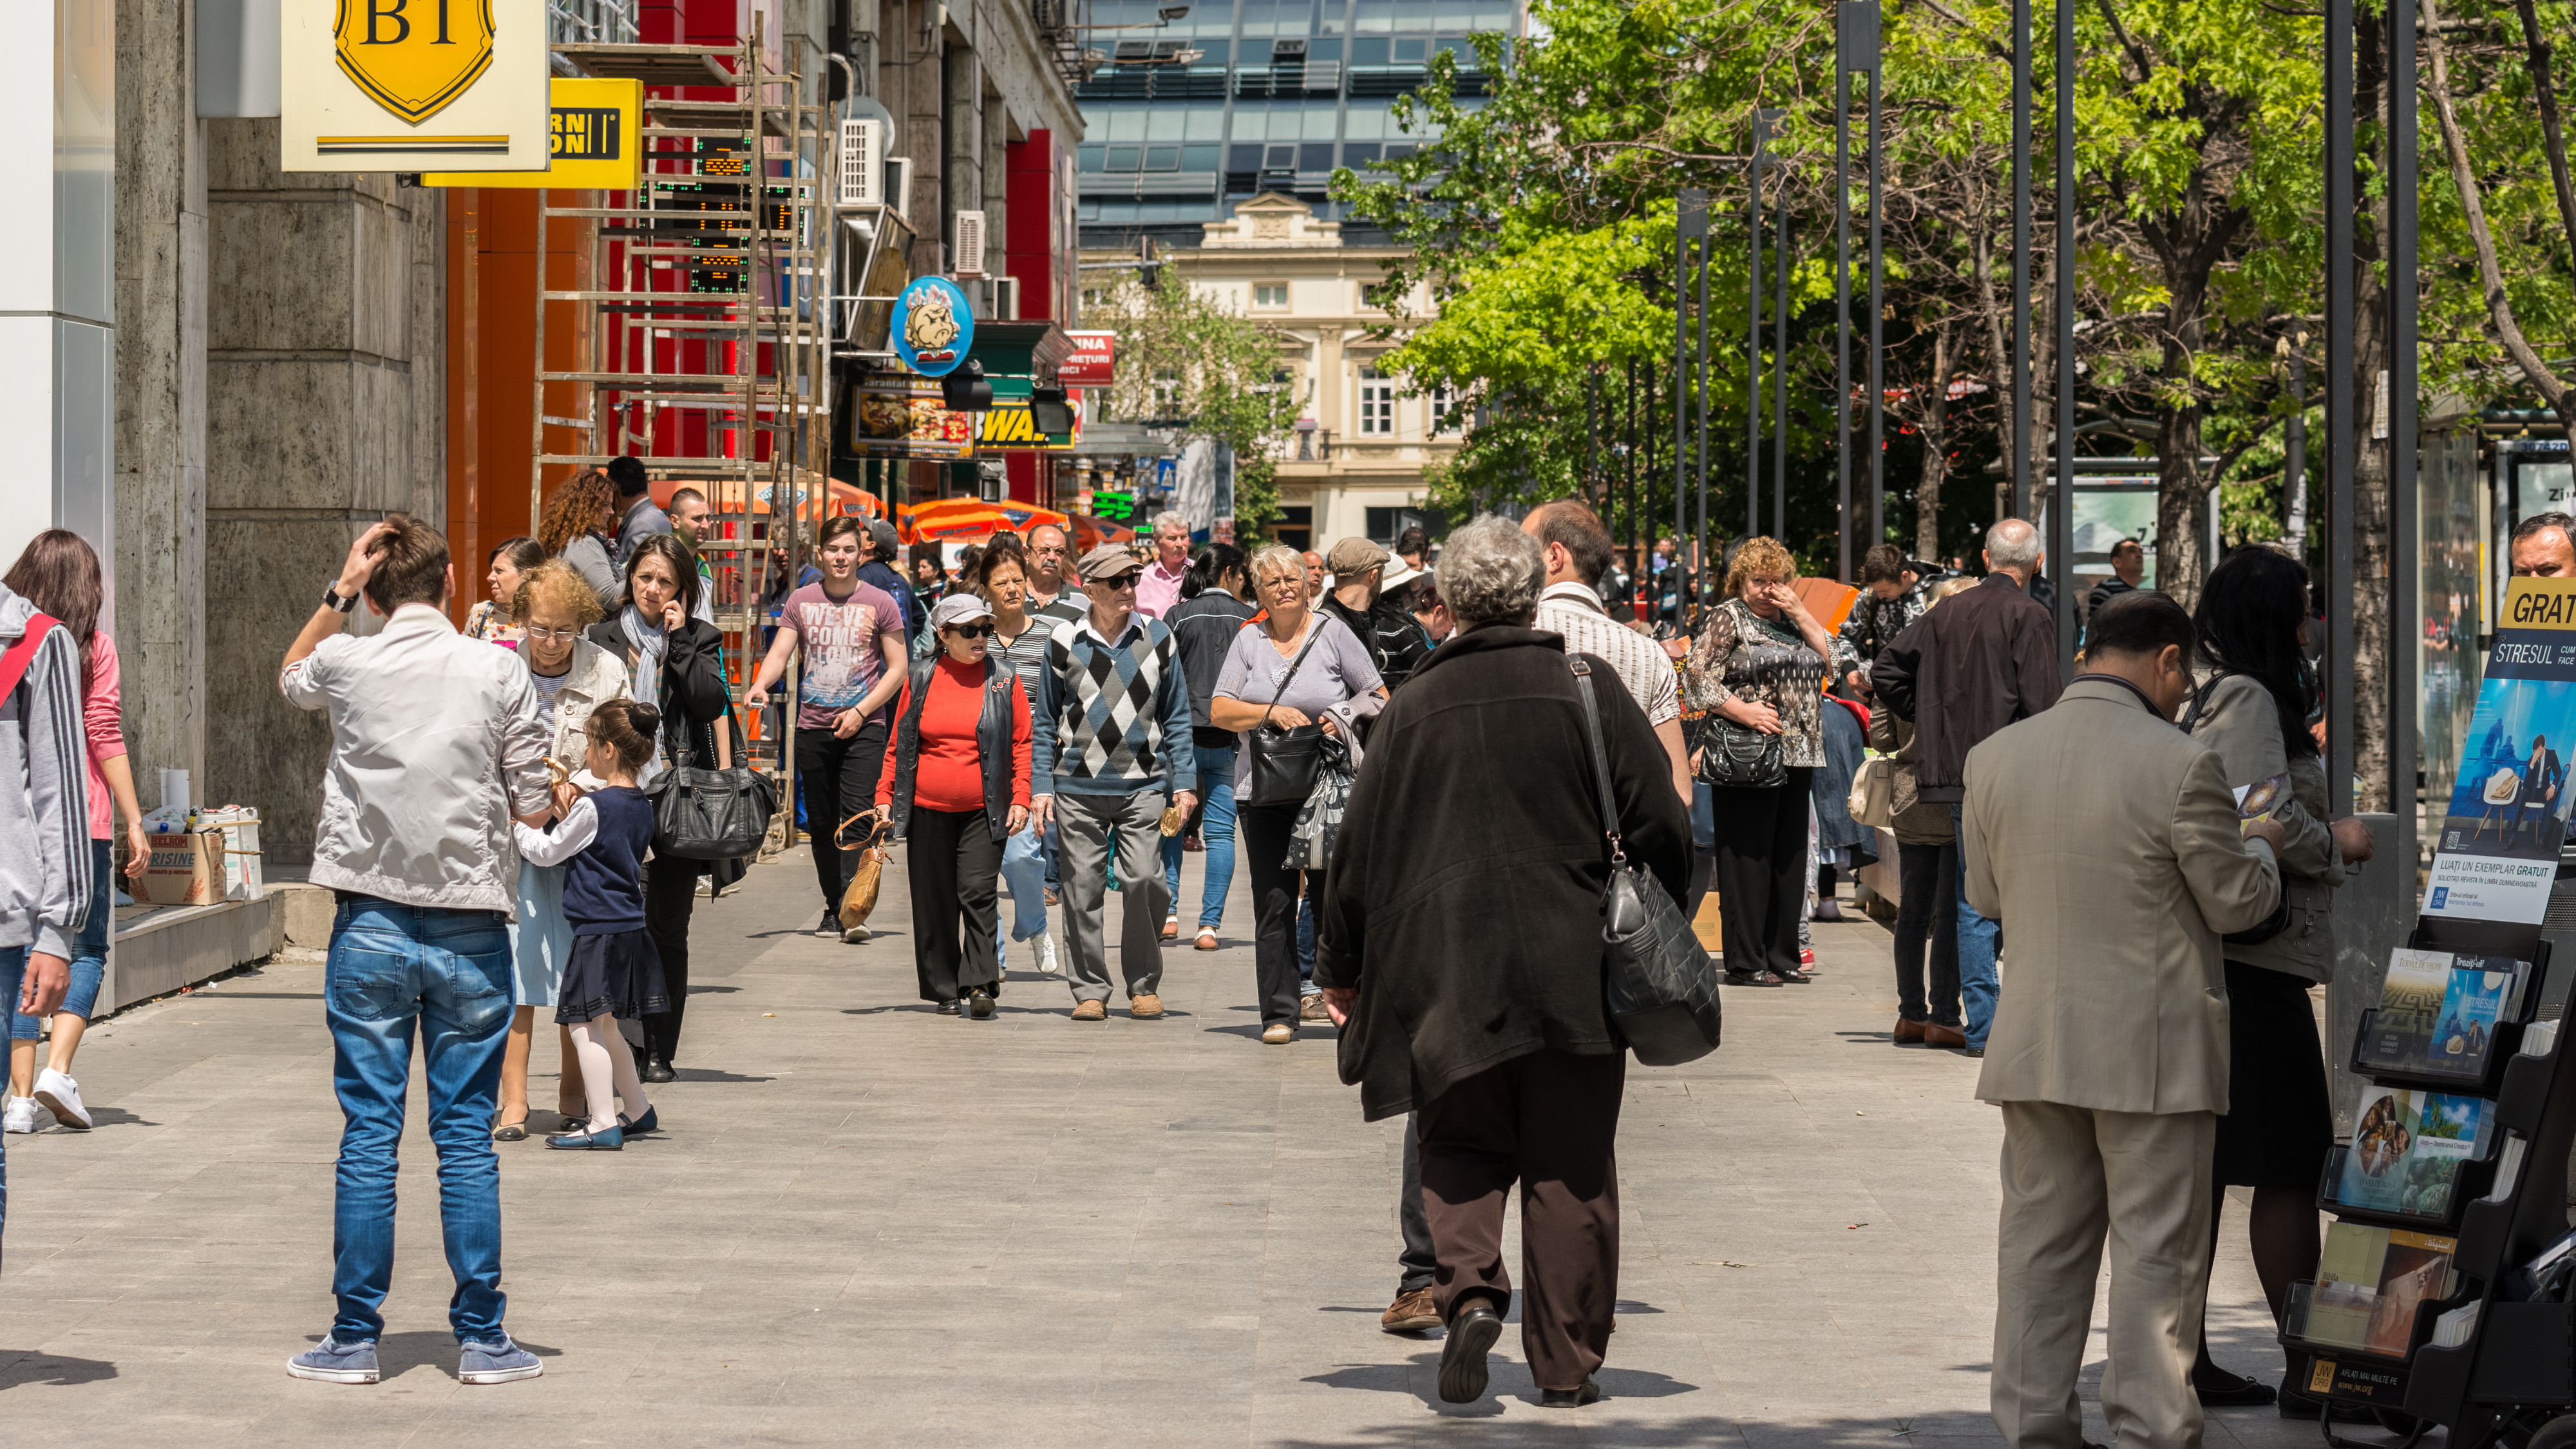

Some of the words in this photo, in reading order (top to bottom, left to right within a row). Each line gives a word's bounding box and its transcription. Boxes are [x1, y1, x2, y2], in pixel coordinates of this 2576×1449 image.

[359, 0, 469, 45] BT
[1066, 355, 1110, 365] REȚURI
[864, 379, 905, 388] arantat
[2522, 442, 2568, 451] 30742D
[806, 605, 866, 627] WE'VE
[808, 626, 860, 647] COME
[817, 645, 864, 666] LONG
[2496, 643, 2553, 665] STRESUL
[2561, 645, 2576, 654] CUM
[2557, 656, 2575, 665] FACE
[151, 836, 188, 848] BELROM
[149, 852, 196, 866] RISINE
[2440, 860, 2461, 873] LUAȚI
[2462, 861, 2473, 871] UN
[2475, 862, 2515, 875] EXEMPLAR
[2517, 866, 2549, 878] GRATUIT
[2499, 879, 2537, 888] DUMNEAVOASTRĂ
[2435, 889, 2446, 899] JW
[2399, 958, 2418, 969] TURNUL
[2419, 961, 2425, 969] DE
[2425, 961, 2442, 971] VEGHE
[2467, 997, 2496, 1010] STRESUL
[2365, 1179, 2381, 1187] VESTE
[2322, 1271, 2339, 1282] Biblia
[2314, 1377, 2329, 1387] ORG
[2341, 1368, 2359, 1380] AFLAȚI
[2359, 1372, 2371, 1380] MAI
[2371, 1374, 2389, 1384] MULTE
[2389, 1377, 2398, 1385] PE
[2338, 1381, 2373, 1396] www.jw.org
